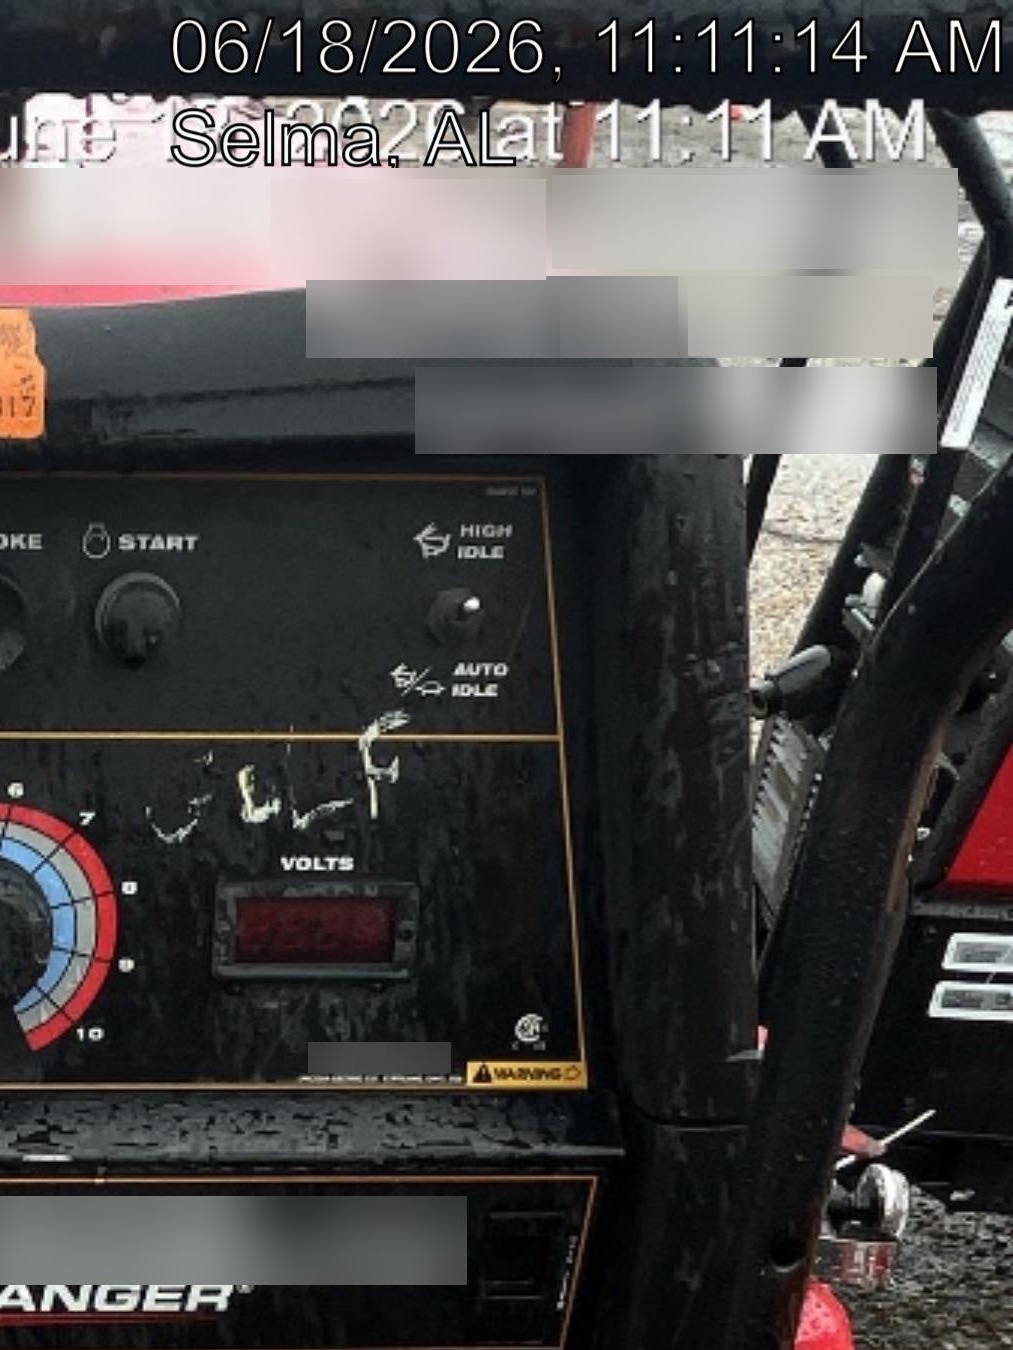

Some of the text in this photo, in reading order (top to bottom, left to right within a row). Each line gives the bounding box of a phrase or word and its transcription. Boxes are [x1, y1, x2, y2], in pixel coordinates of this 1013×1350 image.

[460, 523, 514, 539] HIGH
[118, 532, 199, 551] START
[456, 544, 505, 560] IDLE
[452, 661, 510, 677] AUTO
[451, 683, 499, 698] IDLE
[7, 782, 24, 798] 6
[78, 811, 96, 827] 7
[279, 855, 355, 872] VOLTS
[121, 880, 138, 896] 8
[118, 957, 135, 973] 9
[75, 1027, 105, 1042] 10
[493, 1067, 562, 1081] WARNING
